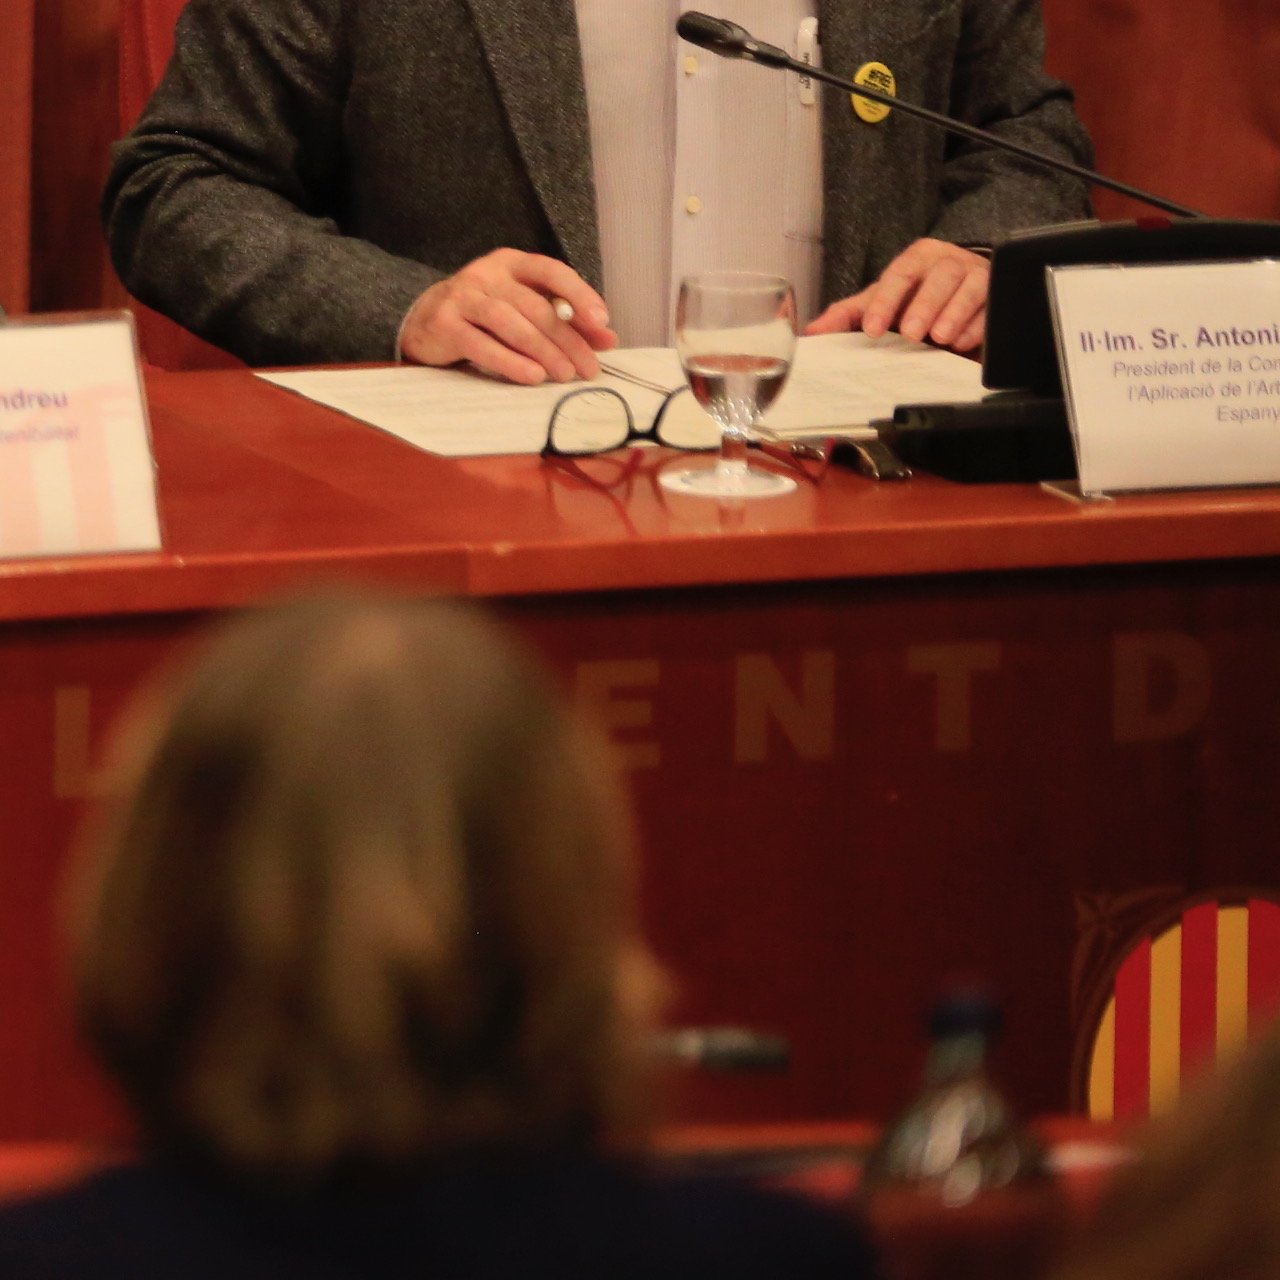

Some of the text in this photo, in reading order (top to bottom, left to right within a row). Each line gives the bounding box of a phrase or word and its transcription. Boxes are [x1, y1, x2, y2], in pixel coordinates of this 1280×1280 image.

[1151, 327, 1188, 350] Sr.
[1196, 324, 1280, 348] Antoni
[1113, 358, 1196, 378] President
[1201, 359, 1222, 375] de
[1228, 357, 1242, 373] la
[1129, 384, 1215, 404] l'Aplicació
[1221, 382, 1241, 397] de
